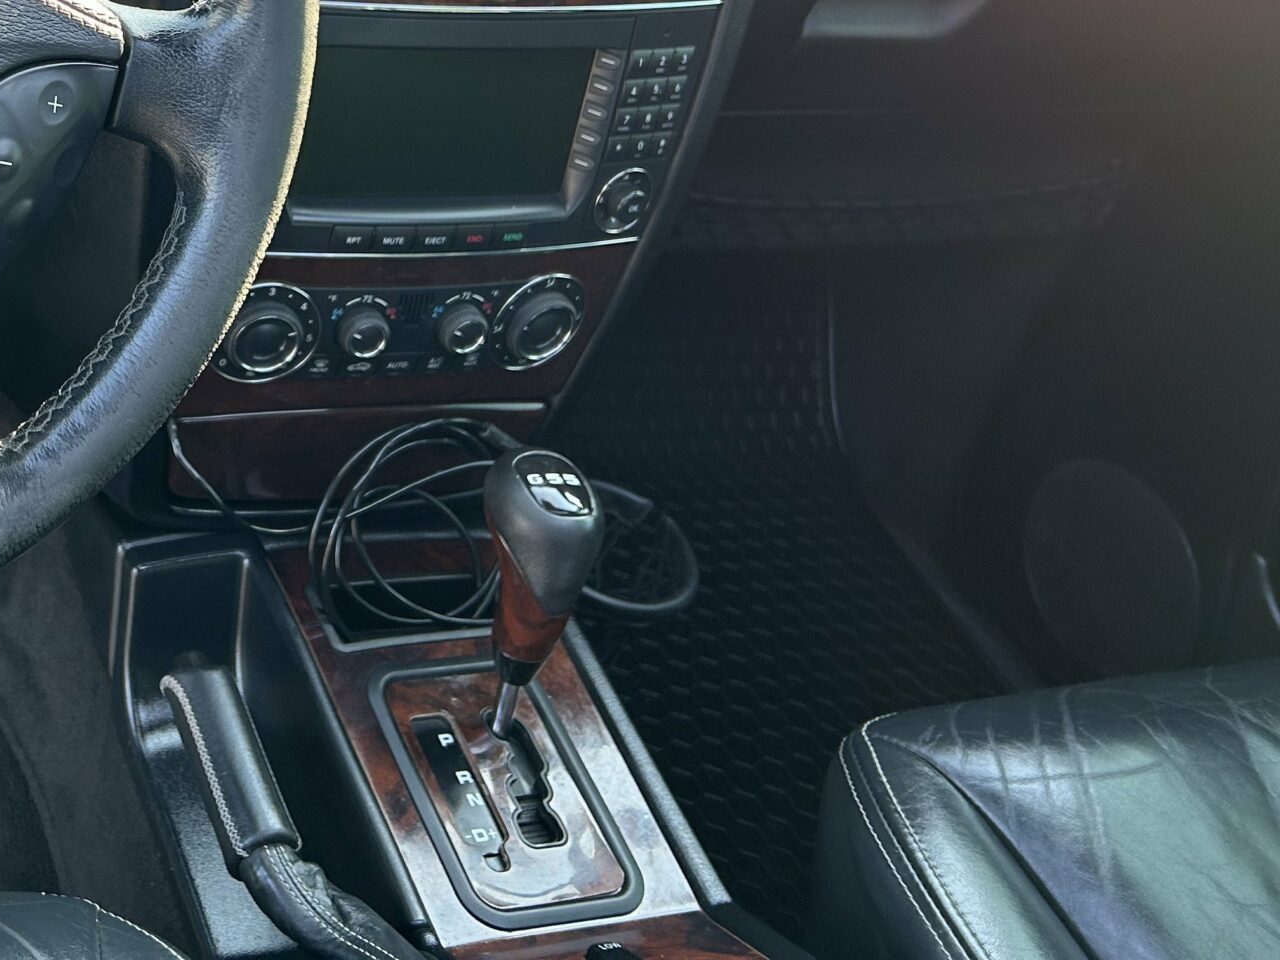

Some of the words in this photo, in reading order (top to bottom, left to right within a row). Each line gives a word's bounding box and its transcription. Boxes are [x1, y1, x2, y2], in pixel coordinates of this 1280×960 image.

[345, 237, 362, 245] RPT
[382, 236, 405, 246] MUTE
[424, 236, 447, 245] EJECT
[503, 232, 524, 241] SEND
[268, 287, 277, 296] 3
[362, 294, 374, 304] 72
[300, 302, 309, 311] 4
[385, 361, 409, 369] AUTO
[526, 472, 582, 487] G55
[438, 733, 455, 747] P
[455, 770, 474, 785] R
[466, 792, 485, 807] N
